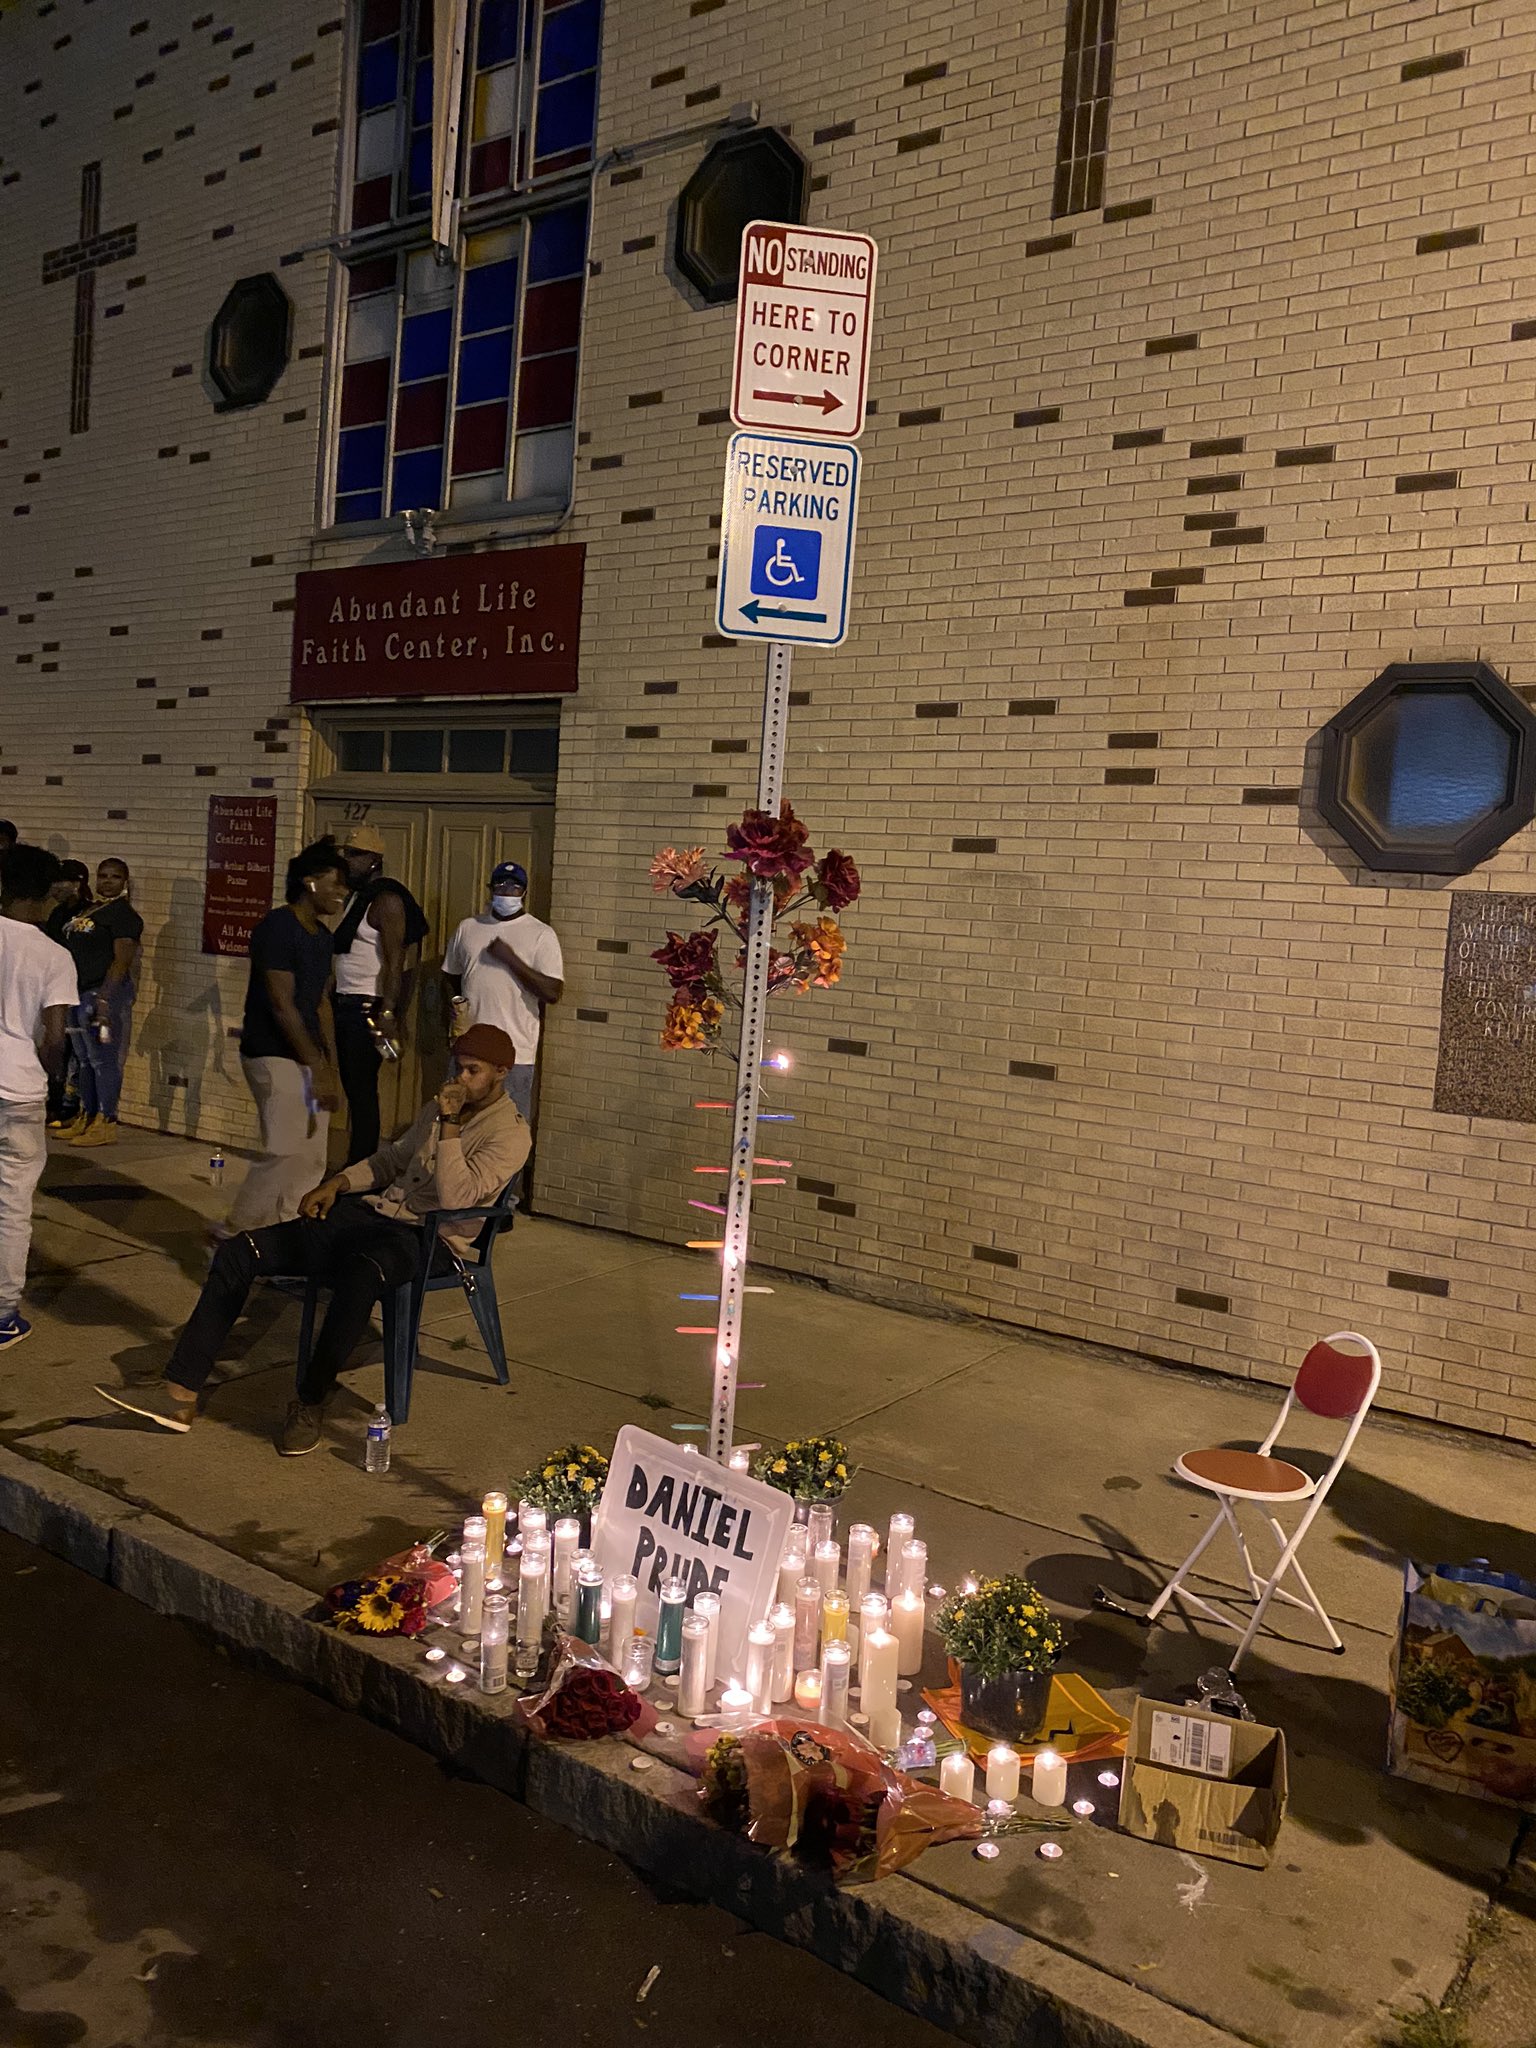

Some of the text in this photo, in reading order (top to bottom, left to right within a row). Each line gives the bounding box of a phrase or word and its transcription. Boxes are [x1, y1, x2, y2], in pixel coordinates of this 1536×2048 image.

[747, 235, 867, 280] NO STANDING
[752, 301, 857, 337] HERE TO
[753, 342, 851, 376] CORNER
[738, 451, 849, 487] RESERVED
[743, 487, 839, 521] PARKING
[328, 581, 537, 623] Abundant Life
[301, 625, 565, 665] Faith Center, Inc.
[229, 819, 252, 831] Faith
[256, 805, 273, 818] Life
[344, 802, 371, 820] 427
[221, 923, 234, 937] All
[1463, 922, 1519, 942] WHICH
[625, 1464, 754, 1561] DANIEL
[631, 1525, 730, 1610] PRUDE
